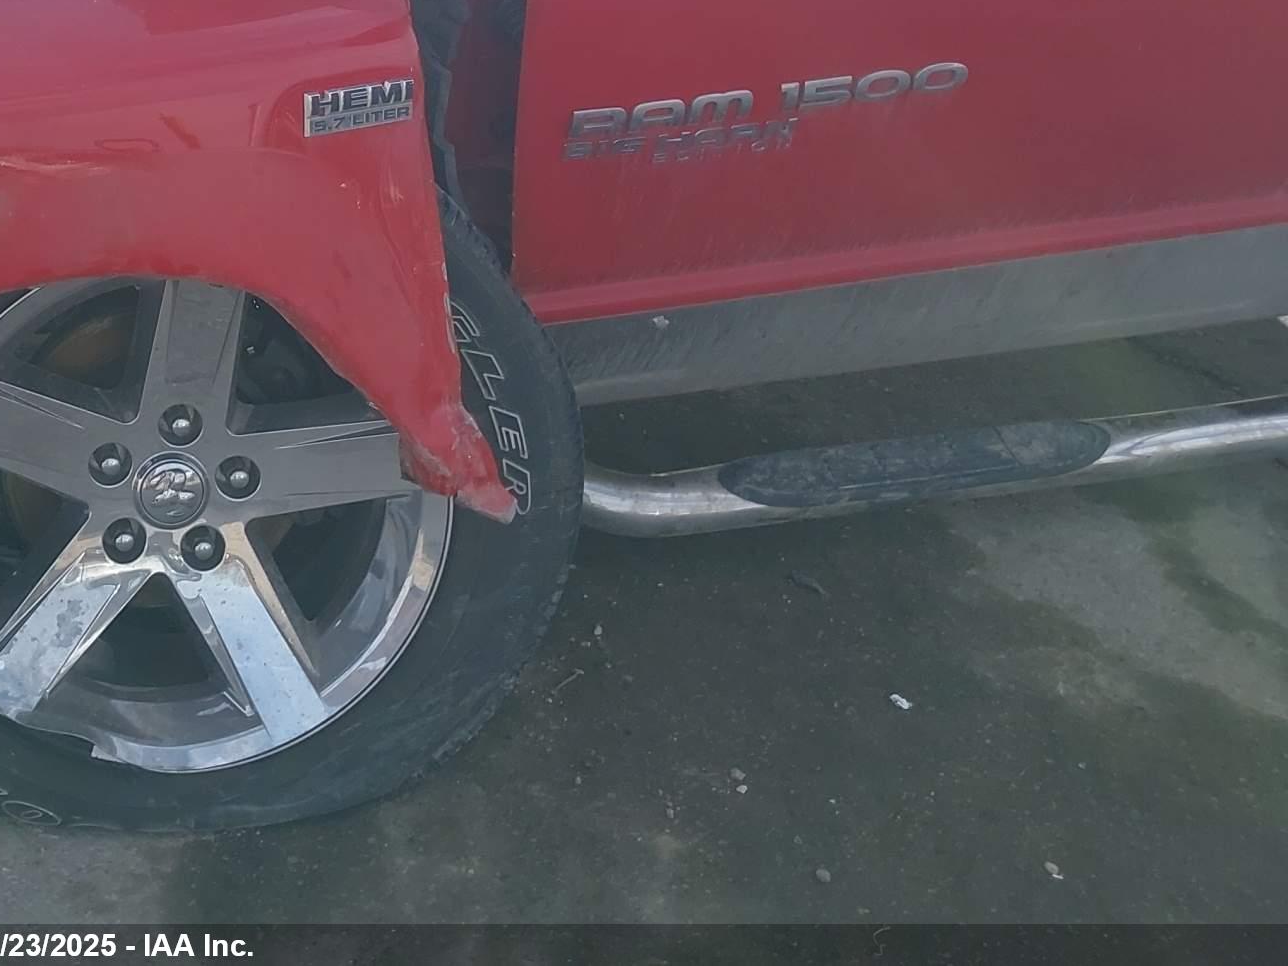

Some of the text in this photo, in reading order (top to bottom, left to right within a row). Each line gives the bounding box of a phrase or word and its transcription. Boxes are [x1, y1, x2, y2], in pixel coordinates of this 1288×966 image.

[304, 80, 414, 116] HEMI
[350, 106, 410, 126] LITER
[569, 62, 969, 138] RAM 1500
